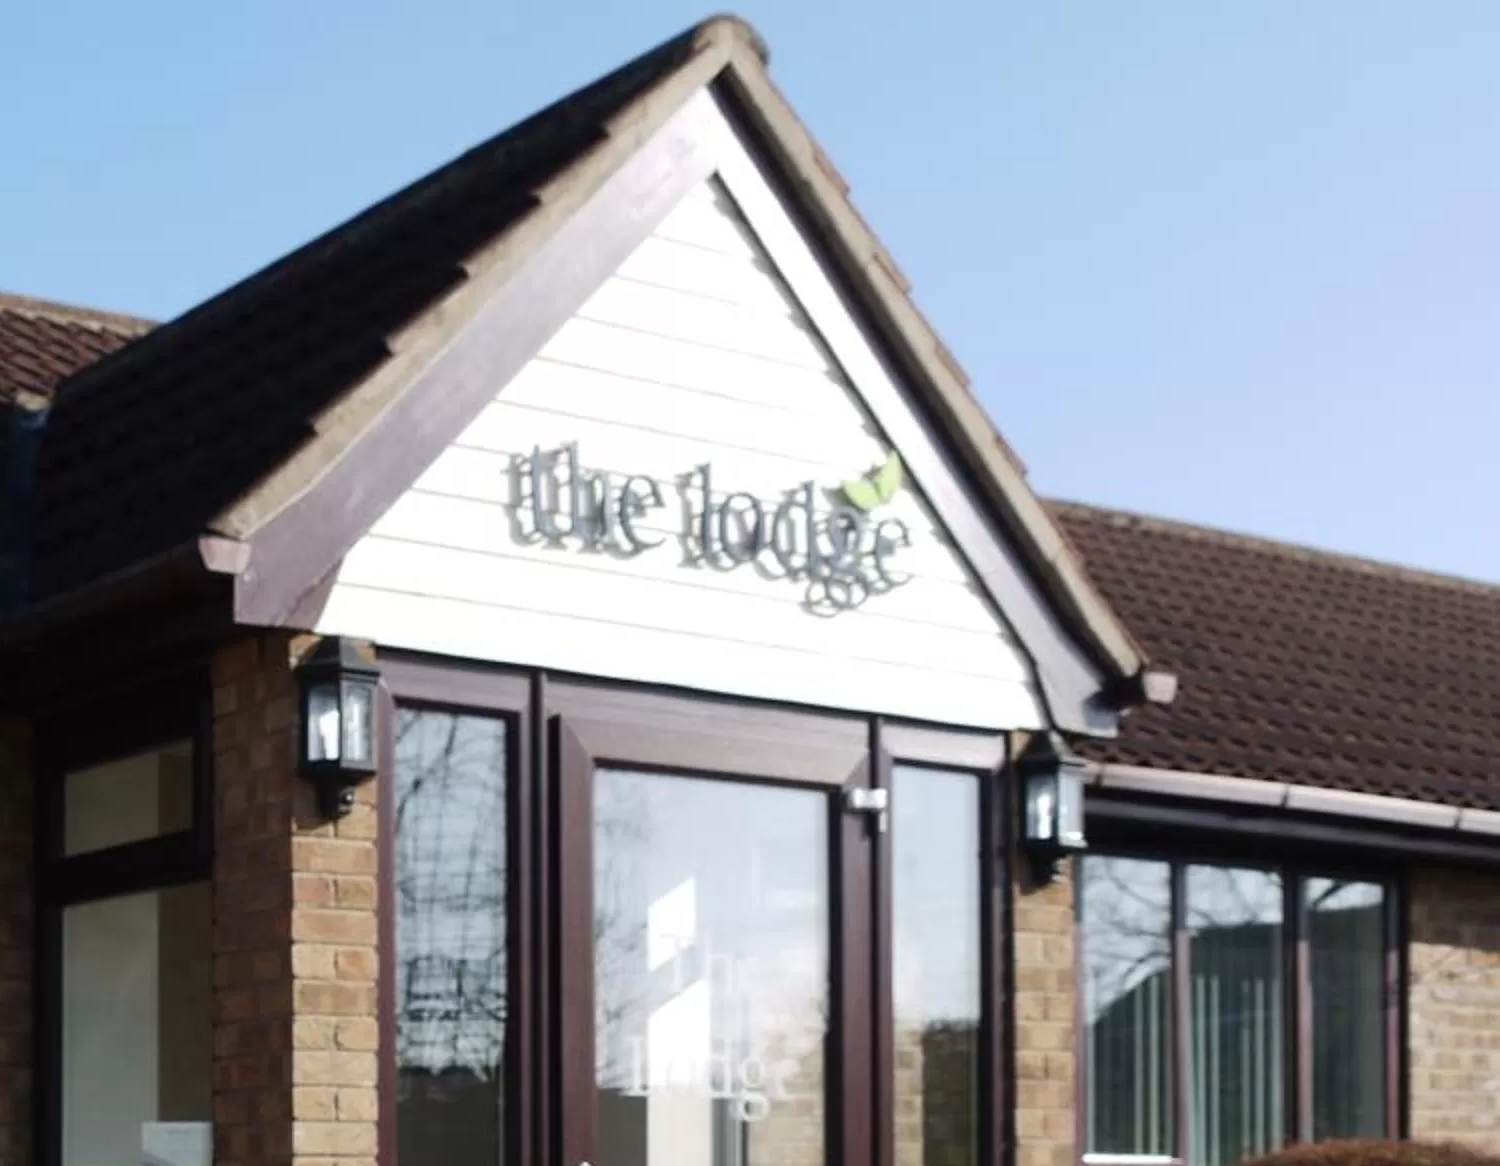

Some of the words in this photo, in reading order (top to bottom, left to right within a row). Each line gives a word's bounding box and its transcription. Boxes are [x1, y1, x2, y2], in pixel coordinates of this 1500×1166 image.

[510, 440, 667, 557] the
[684, 462, 914, 616] lodge
[619, 1035, 804, 1123] Lodge
